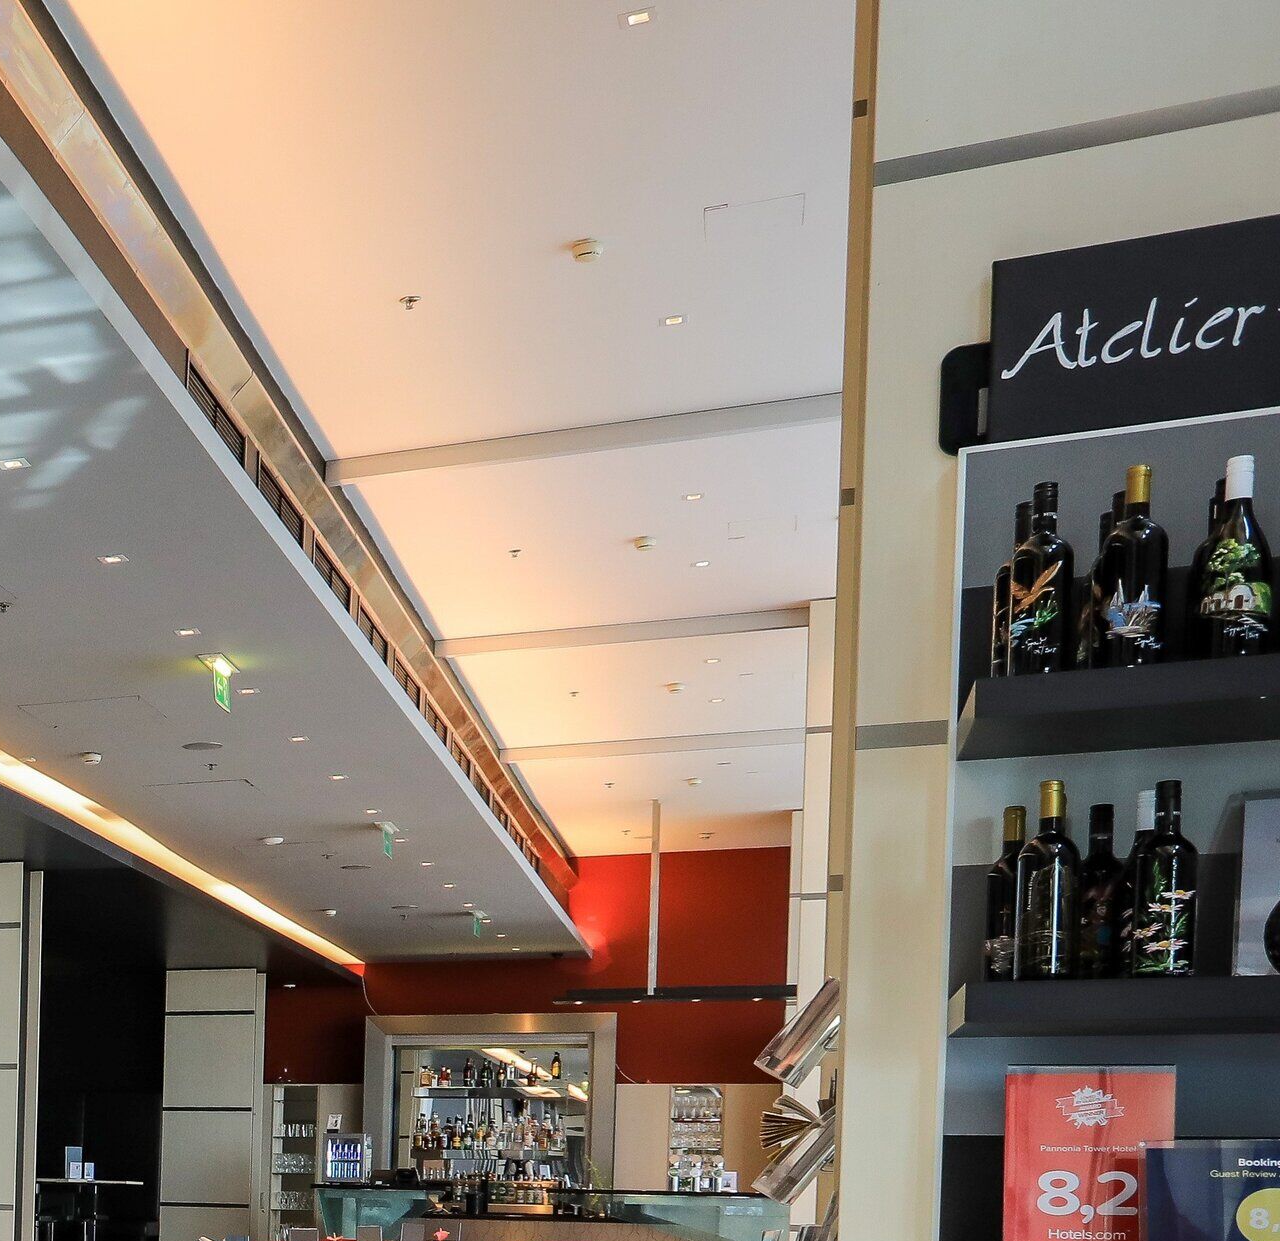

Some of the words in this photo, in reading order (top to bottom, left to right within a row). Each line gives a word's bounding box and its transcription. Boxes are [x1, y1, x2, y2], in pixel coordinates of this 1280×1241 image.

[1001, 297, 1266, 380] Atelier
[1040, 1144, 1081, 1153] Pannonia
[1083, 1144, 1110, 1153] Tower
[1112, 1144, 1138, 1153] Hotel
[1209, 1169, 1240, 1178] Guest
[1242, 1169, 1277, 1178] Review
[1037, 1170, 1138, 1224] 8,2
[1047, 1228, 1126, 1240] Hotels.com
